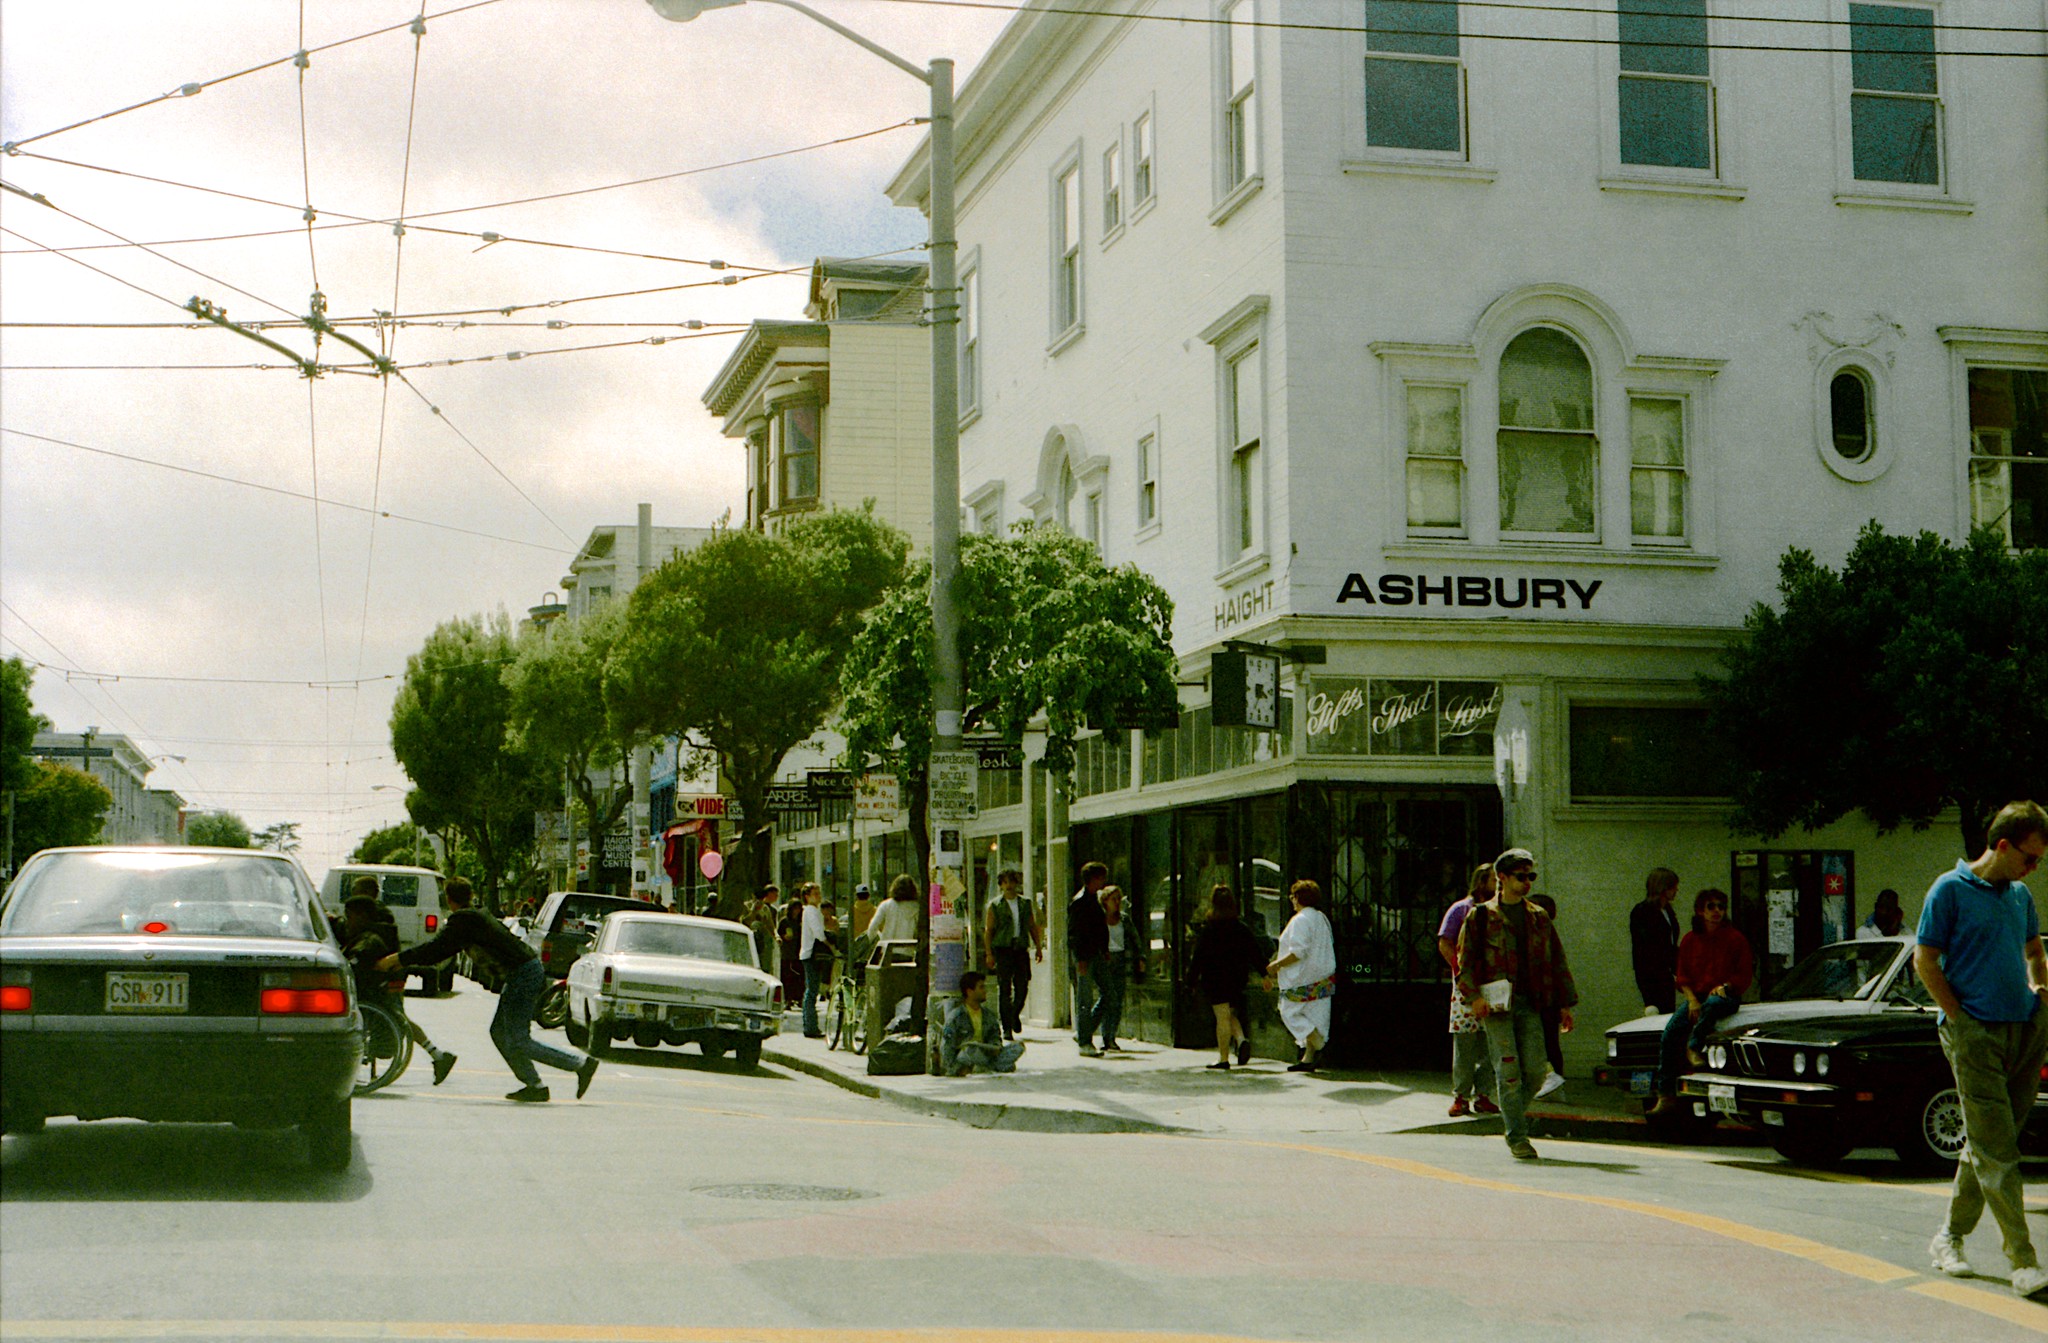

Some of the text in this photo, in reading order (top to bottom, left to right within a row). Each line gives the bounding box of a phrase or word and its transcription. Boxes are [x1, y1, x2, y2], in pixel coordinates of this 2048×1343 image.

[1335, 573, 1603, 610] ASHBURY
[1214, 580, 1276, 632] HAIGHT
[1307, 687, 1365, 736] Gifts
[1372, 685, 1434, 735] That
[1441, 686, 1500, 737] Last
[932, 755, 975, 765] SKATEBOARD
[811, 776, 837, 786] Nice
[696, 798, 727, 815] VIDE
[602, 844, 632, 852] ASHBUR
[605, 851, 632, 859] MUSIC
[602, 859, 631, 868] CENTE
[110, 981, 183, 1004] CSR 911
